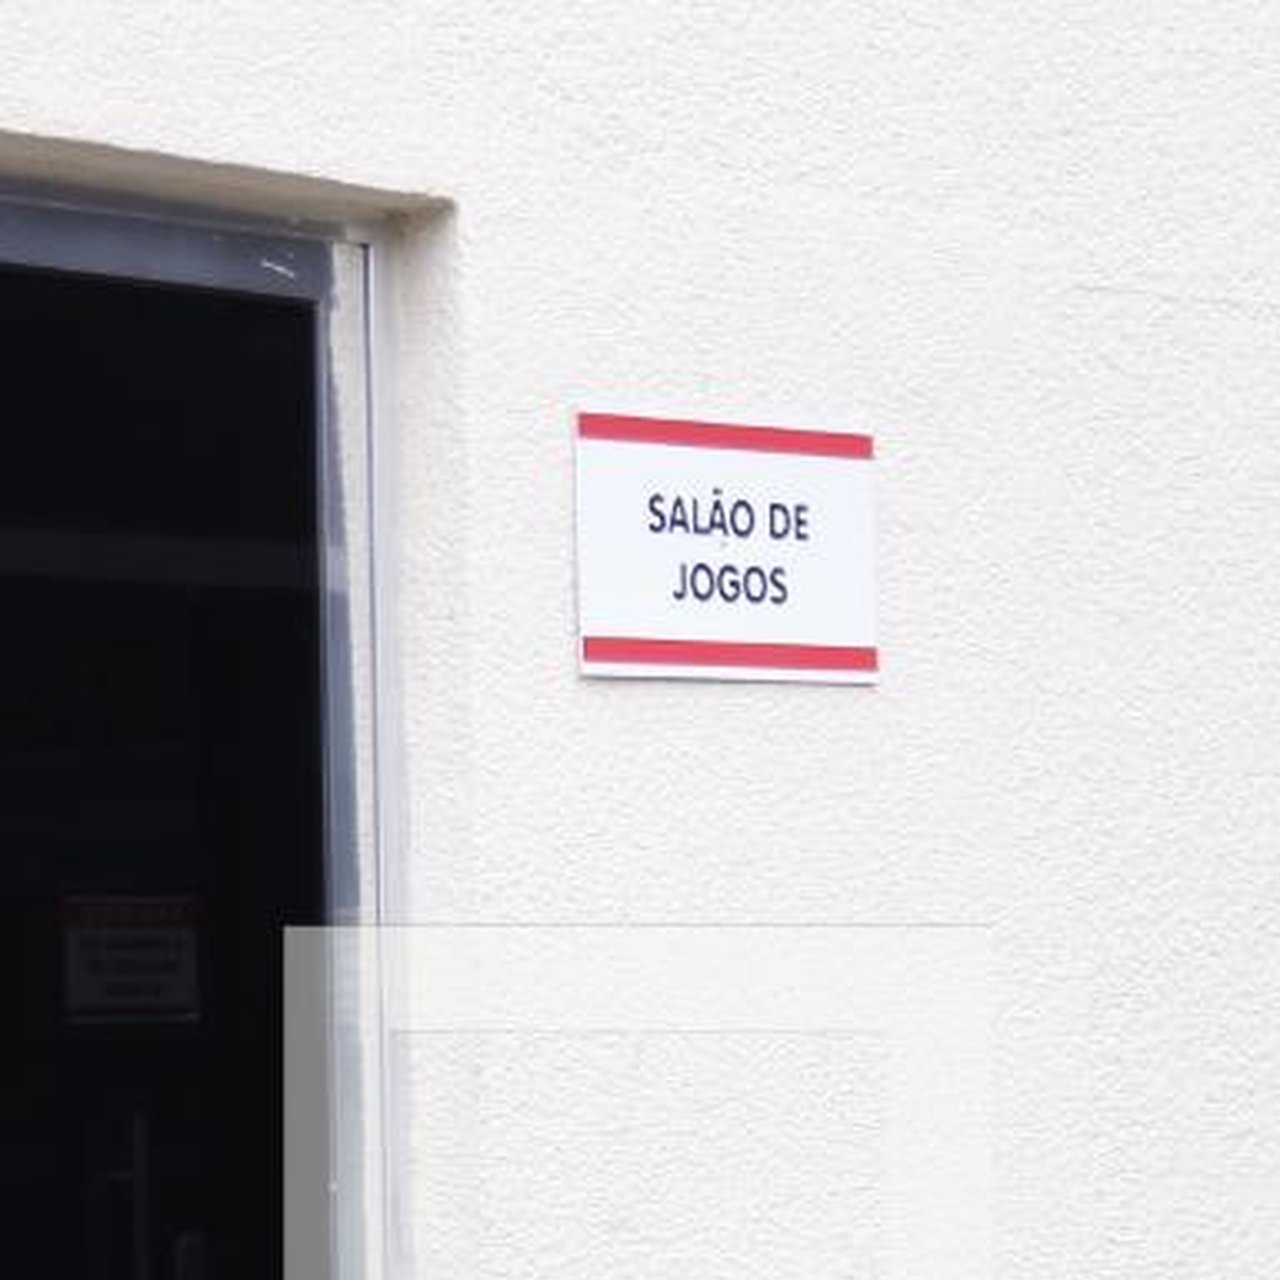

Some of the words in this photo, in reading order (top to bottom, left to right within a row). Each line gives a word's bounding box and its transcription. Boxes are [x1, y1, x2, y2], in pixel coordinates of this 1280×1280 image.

[647, 487, 756, 539] SALÃO
[768, 502, 810, 542] DE
[672, 562, 789, 606] JOGOS
